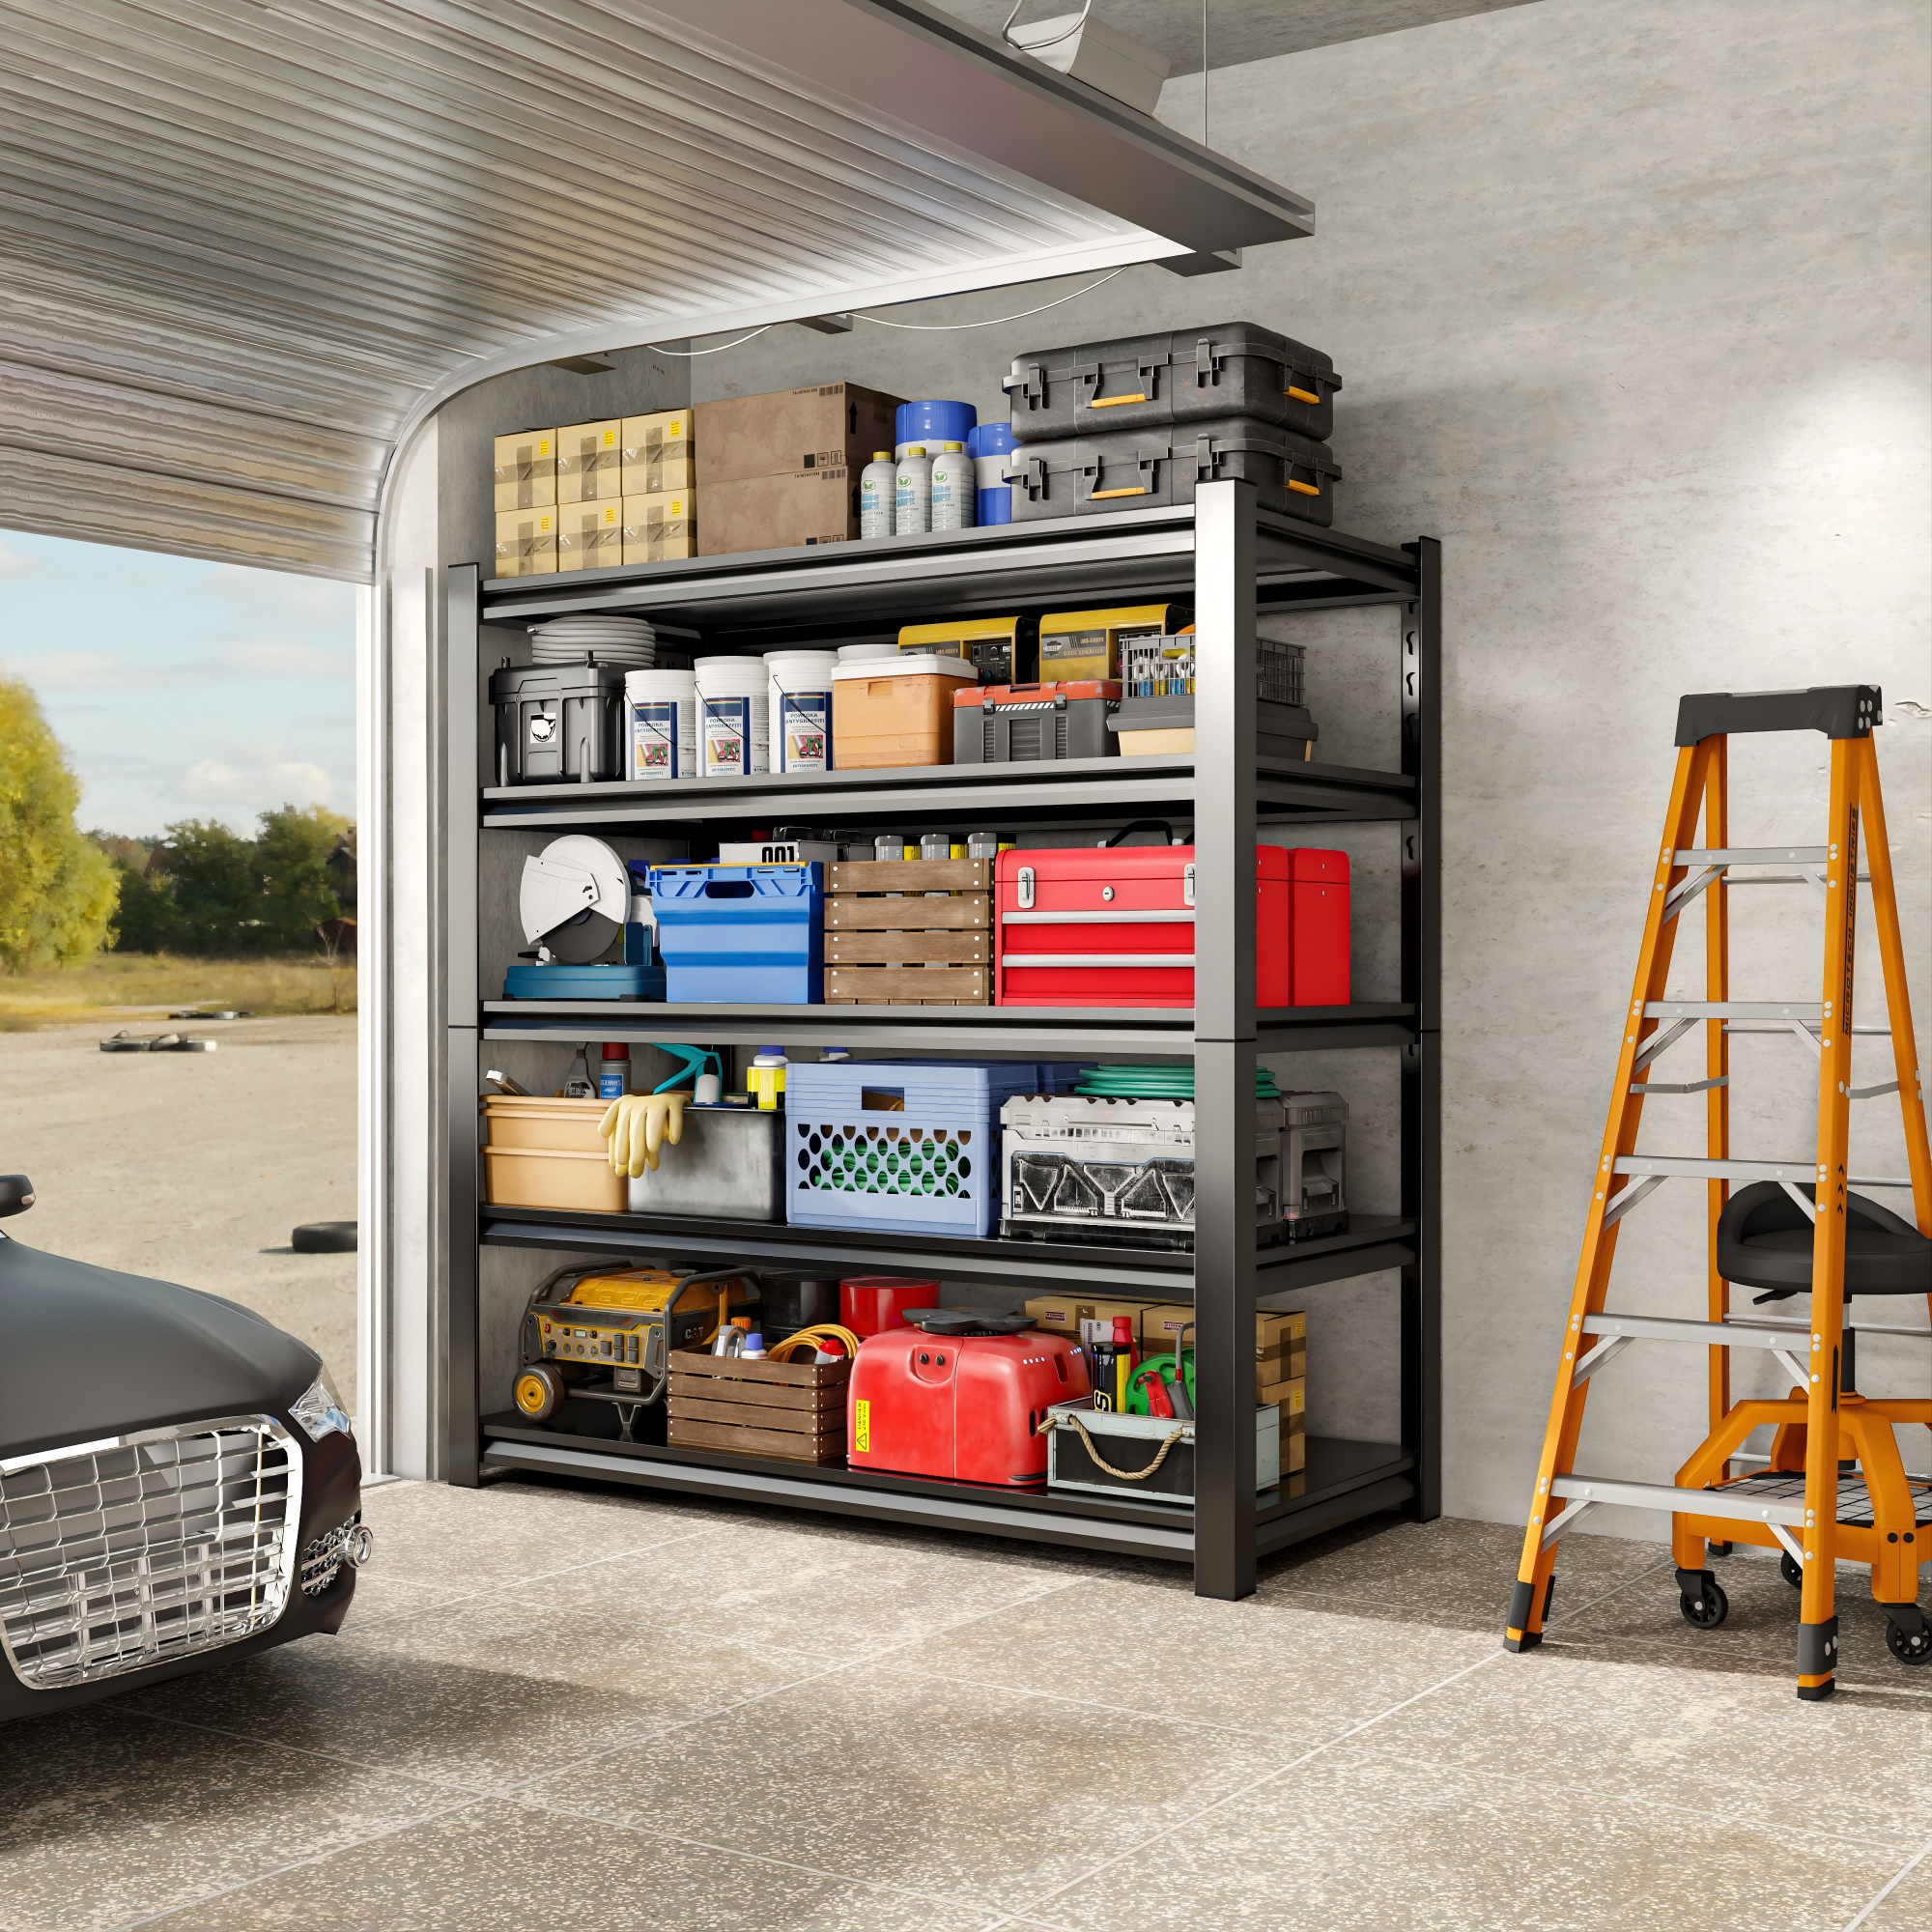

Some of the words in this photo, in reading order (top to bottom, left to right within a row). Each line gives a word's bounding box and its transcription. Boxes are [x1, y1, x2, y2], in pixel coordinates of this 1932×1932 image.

[761, 845, 795, 863] 001
[1844, 927, 1853, 1036] MICROTECH
[1849, 807, 1858, 918] INDUSTRIES
